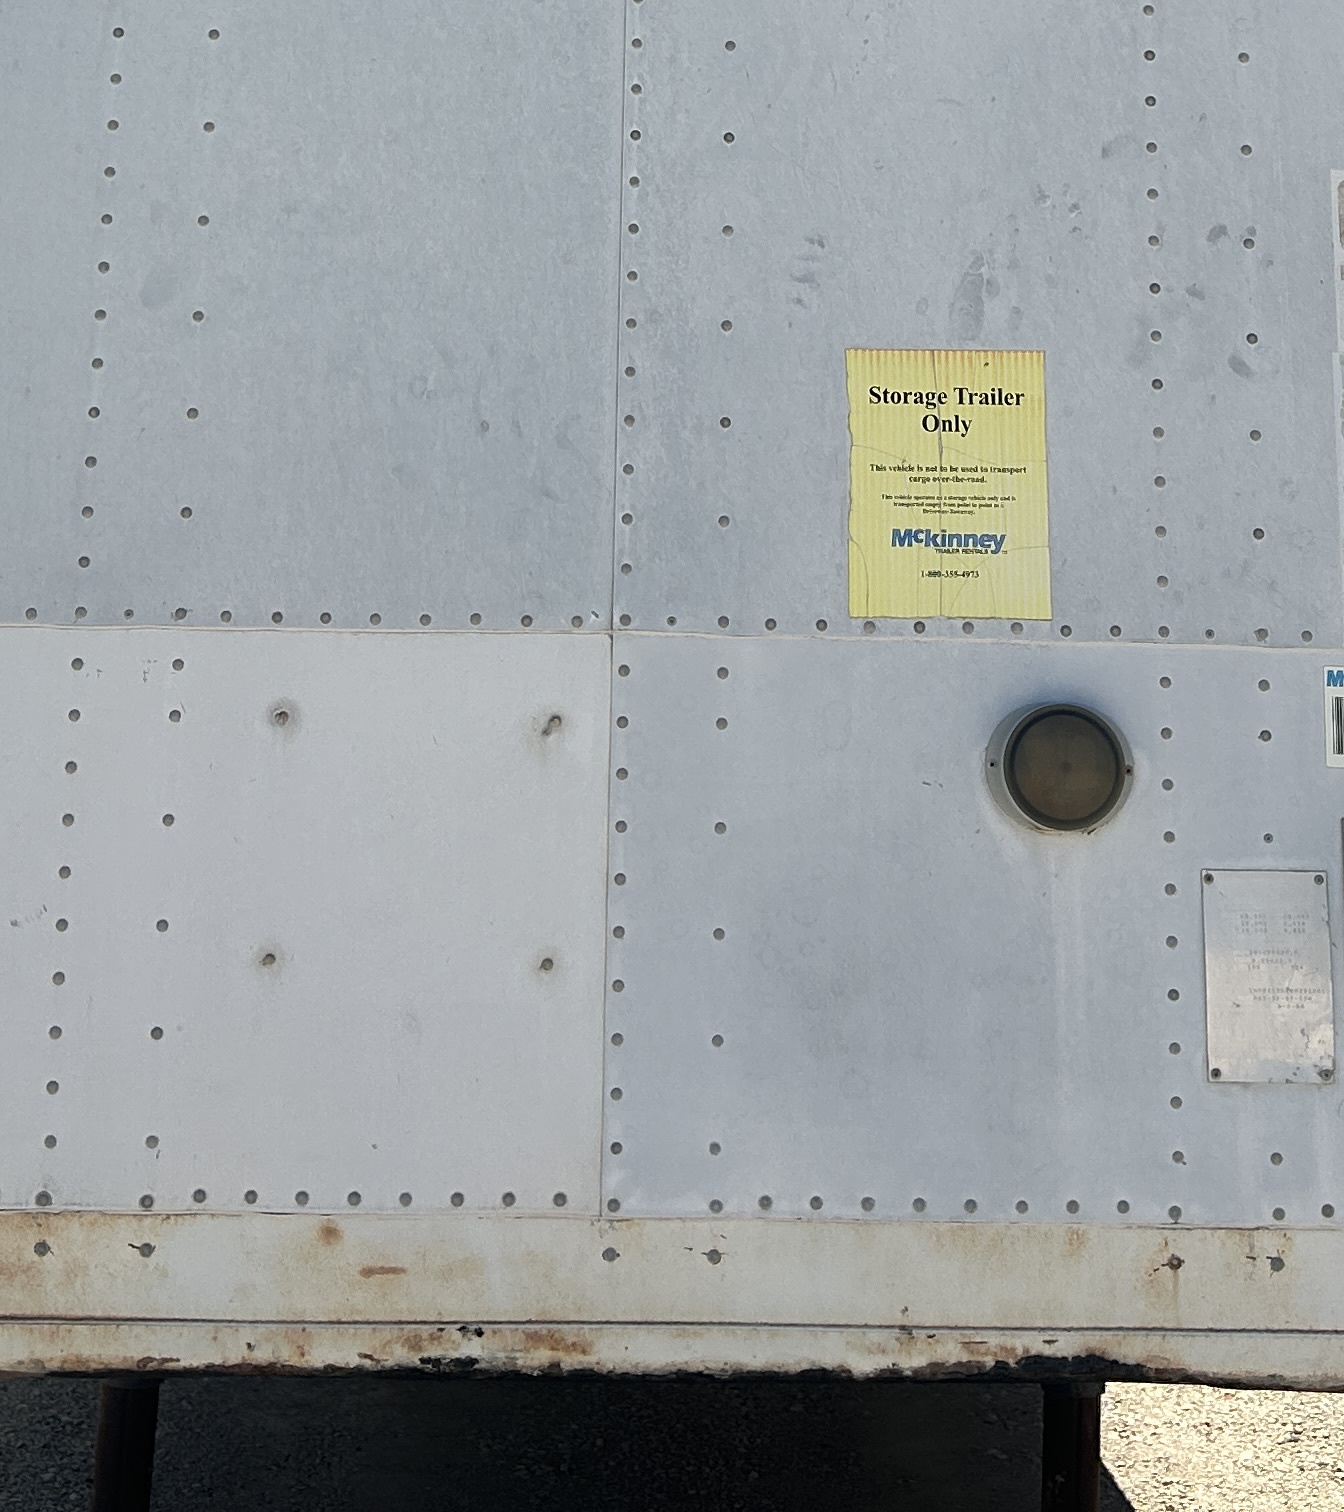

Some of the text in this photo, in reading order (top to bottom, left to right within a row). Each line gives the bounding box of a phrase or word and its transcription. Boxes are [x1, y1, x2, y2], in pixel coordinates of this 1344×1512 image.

[869, 385, 1025, 410] Storage Trailer
[921, 413, 973, 438] Only
[869, 463, 887, 473] This
[889, 463, 915, 473] vehicle
[916, 464, 924, 473] is
[925, 465, 938, 473] not
[960, 465, 978, 474] used
[980, 465, 989, 474] to
[990, 465, 1027, 476] transport
[908, 475, 931, 485] cargo
